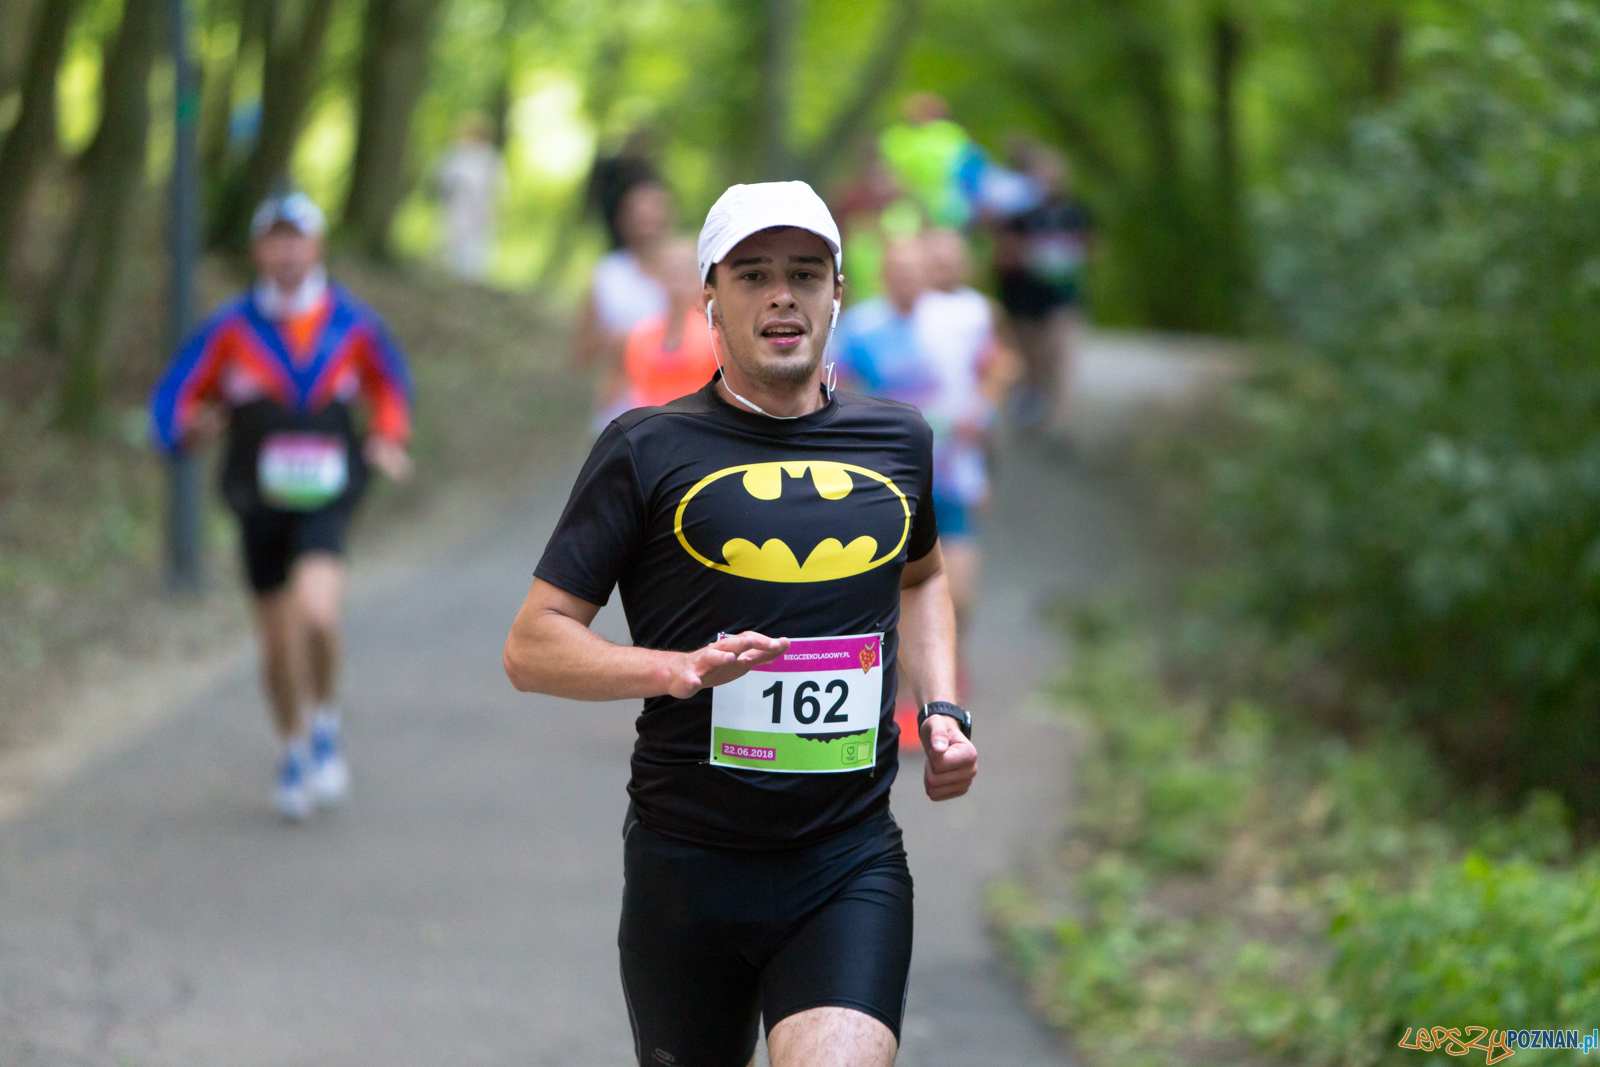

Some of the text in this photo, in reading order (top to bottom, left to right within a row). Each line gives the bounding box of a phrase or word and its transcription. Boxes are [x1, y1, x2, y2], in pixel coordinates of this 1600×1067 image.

[783, 652, 851, 661] BIEGCZEKOLADOWY.PL
[762, 679, 849, 725] 162
[723, 745, 774, 759] 22.06.2018
